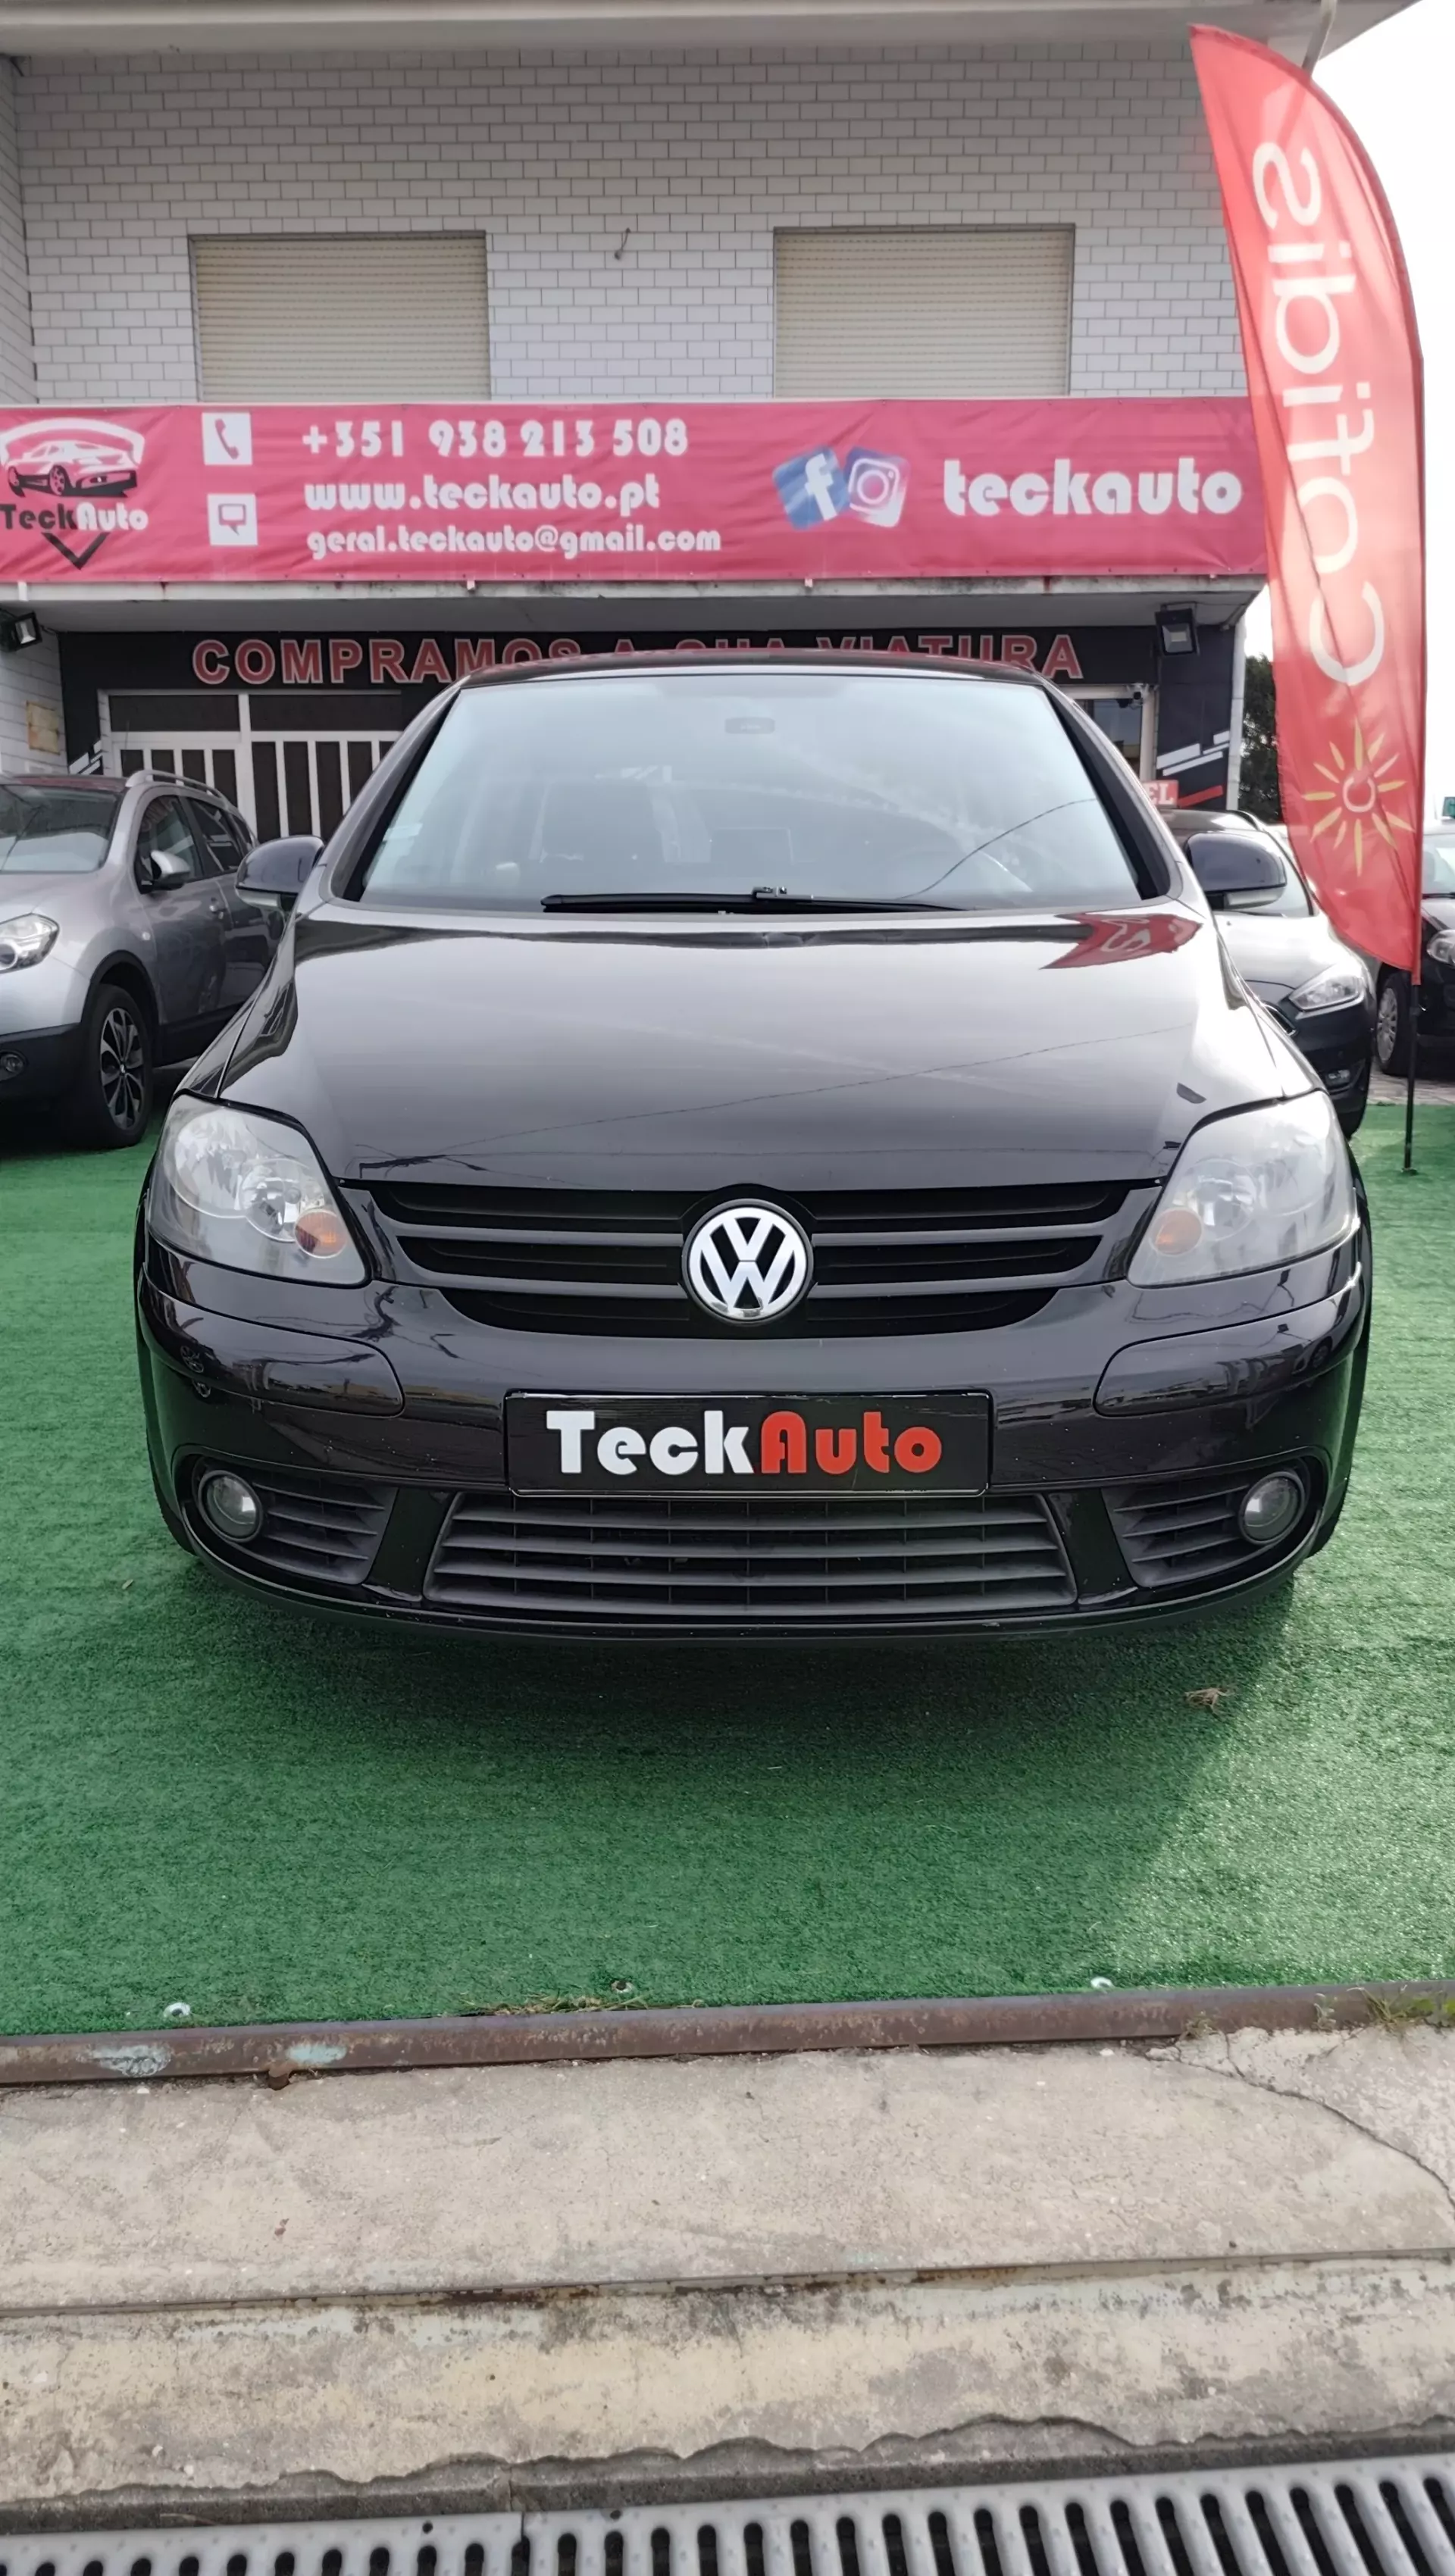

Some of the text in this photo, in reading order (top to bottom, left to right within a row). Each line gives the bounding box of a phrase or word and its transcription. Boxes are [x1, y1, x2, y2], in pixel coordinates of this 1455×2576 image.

[302, 417, 689, 458] +351 938 213 508
[304, 474, 660, 517] www.teckauto.pt
[943, 457, 1244, 516] teckauto
[0, 501, 150, 530] TeckAuto
[305, 523, 722, 560] geral.teckauto@gmail.com
[545, 1409, 943, 1476] TeckAuto
